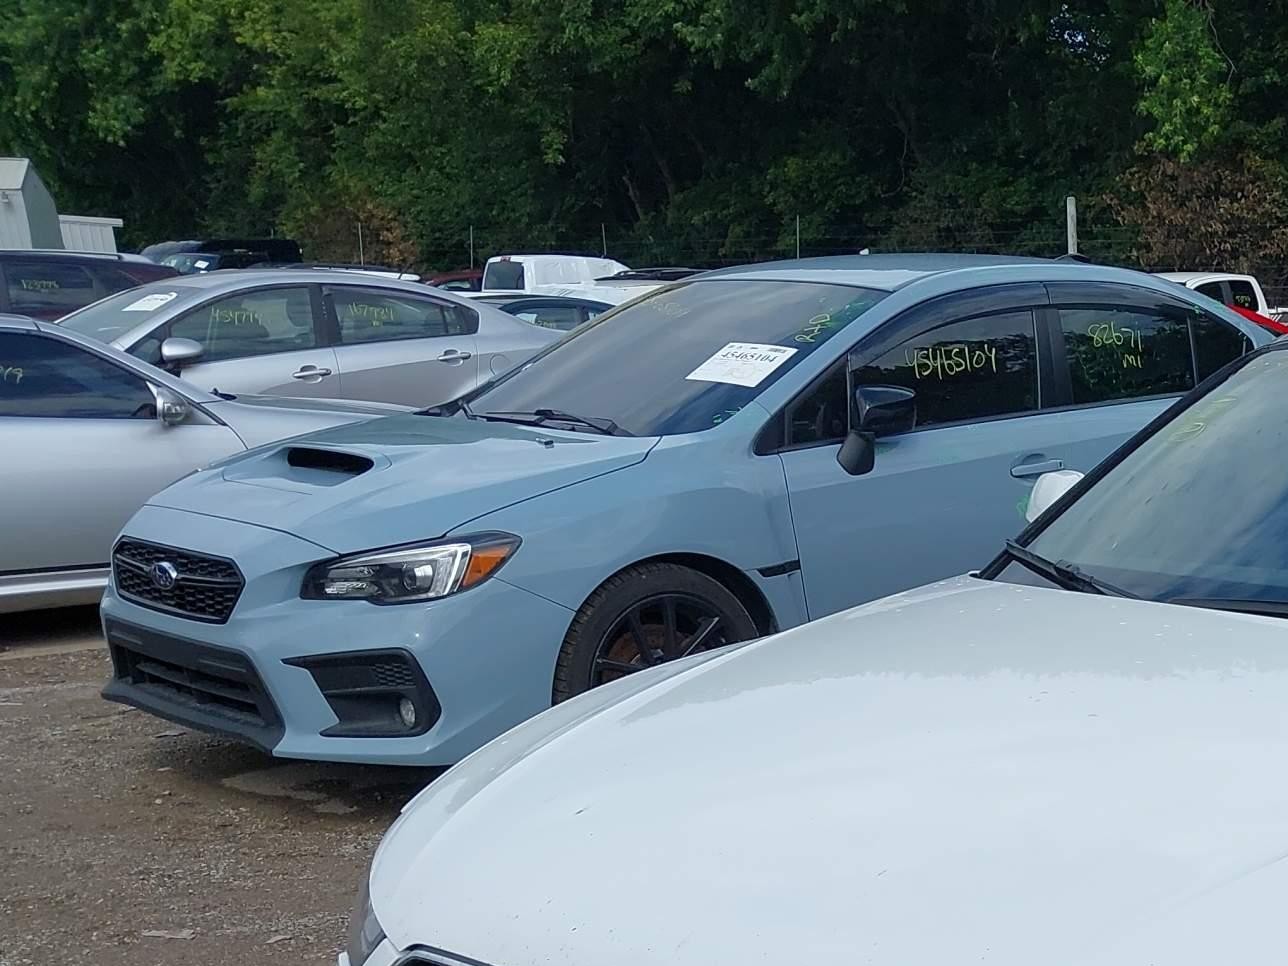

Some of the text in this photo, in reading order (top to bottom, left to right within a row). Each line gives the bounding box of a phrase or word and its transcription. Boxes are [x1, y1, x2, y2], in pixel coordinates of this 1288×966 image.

[1087, 321, 1143, 352] 82671
[721, 351, 779, 362] 45465104
[905, 344, 997, 382] 45465104
